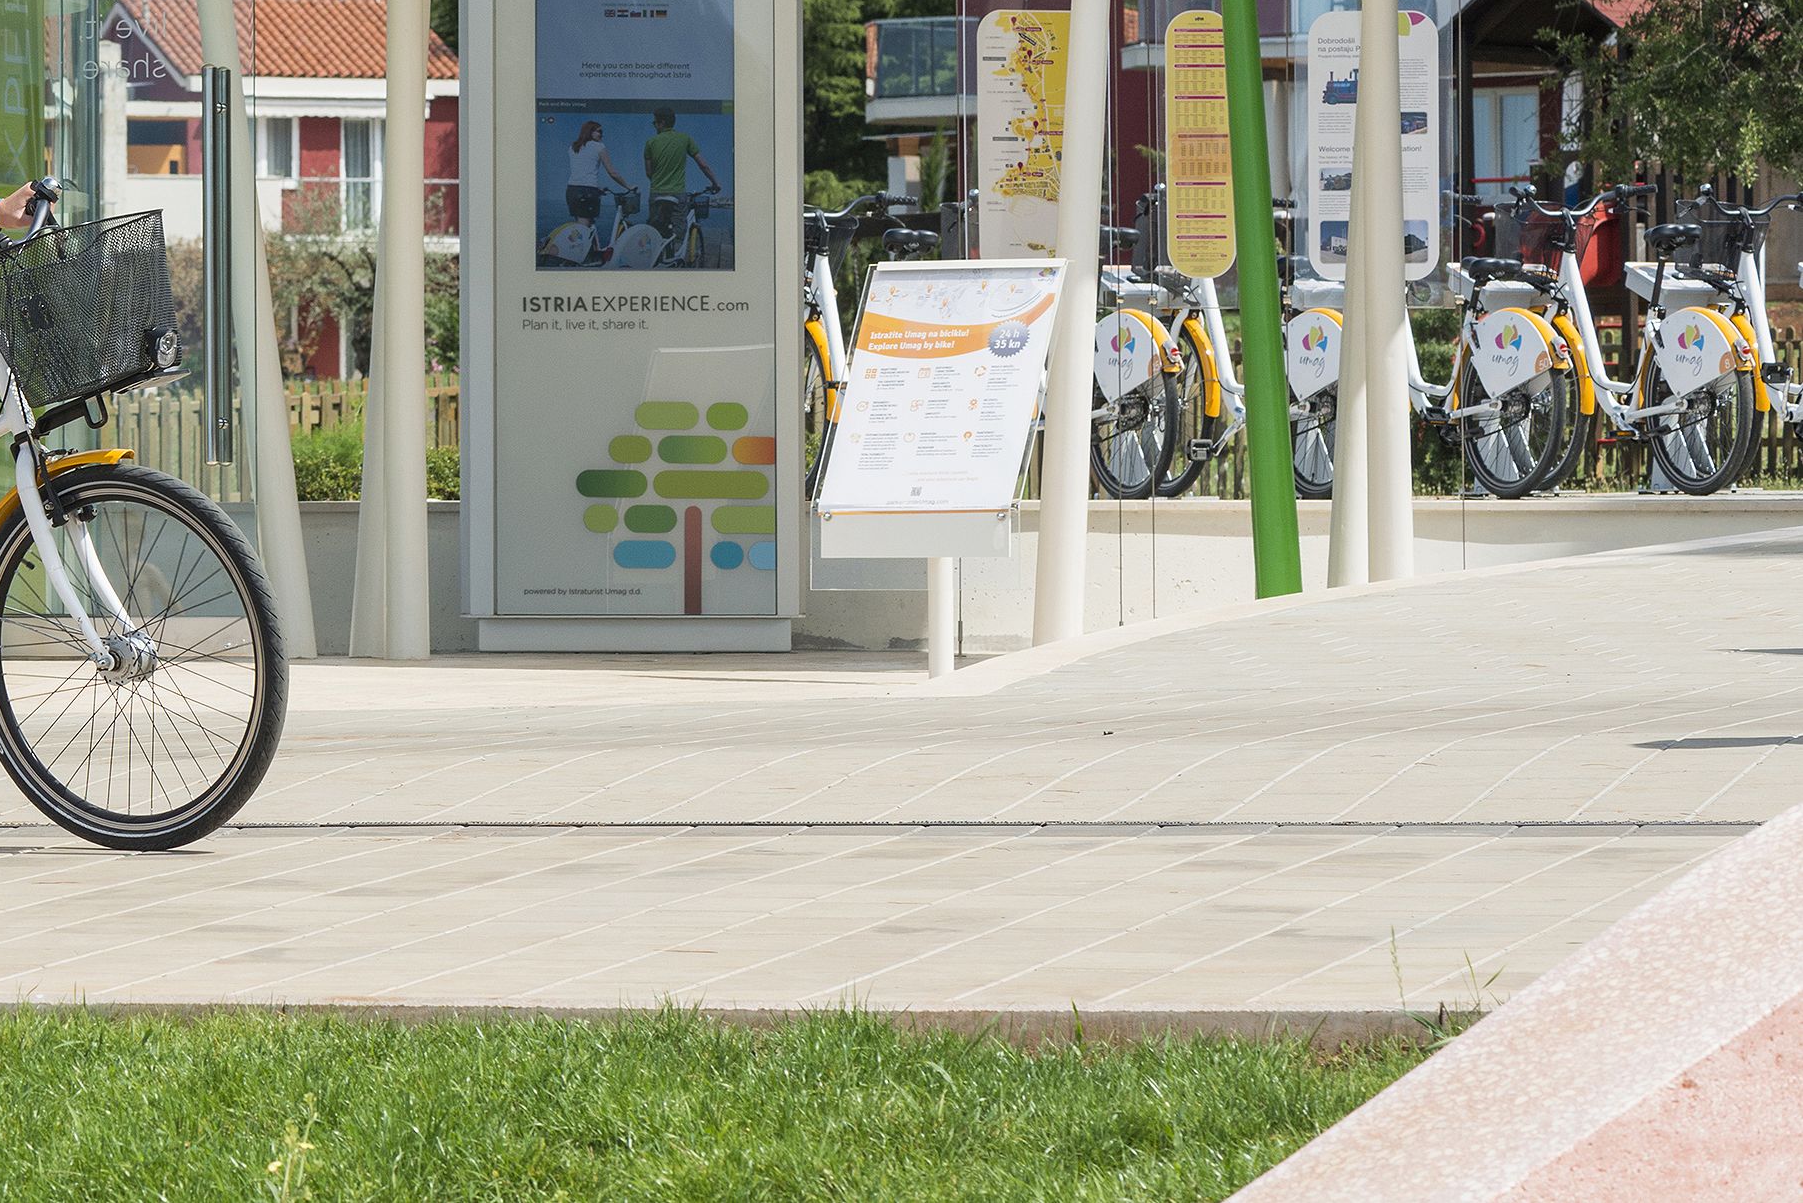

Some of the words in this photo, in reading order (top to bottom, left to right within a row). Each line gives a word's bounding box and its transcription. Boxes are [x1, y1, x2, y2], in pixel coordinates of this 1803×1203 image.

[1318, 37, 1356, 45] Dobrodošli
[1328, 45, 1354, 54] postaju
[582, 62, 601, 70] Here
[602, 63, 618, 71] you
[635, 61, 655, 70] book
[657, 61, 690, 70] different
[579, 71, 627, 79] experiences
[628, 71, 671, 80] throughout
[1318, 145, 1351, 154] Welcome
[1402, 145, 1422, 153] ation!
[522, 319, 549, 331] Plan
[551, 319, 562, 331] it,
[565, 319, 586, 330] live
[602, 319, 636, 330] share
[638, 319, 649, 330] it.
[870, 330, 903, 340] Istražite
[904, 331, 927, 340] Umag
[928, 331, 938, 339] na
[939, 329, 969, 338] biciklu!
[999, 329, 1012, 338] 24
[1013, 329, 1020, 338] h
[868, 342, 898, 351] Explore
[899, 342, 922, 351] Umag
[923, 342, 934, 350] by
[934, 340, 955, 349] bike!
[994, 340, 1009, 349] 35
[1010, 340, 1021, 349] kn
[1299, 357, 1326, 379] umag
[1491, 354, 1520, 377] umag
[1676, 354, 1703, 377] umag
[524, 588, 556, 596] powered
[558, 588, 567, 596] by
[605, 588, 627, 596] Umag
